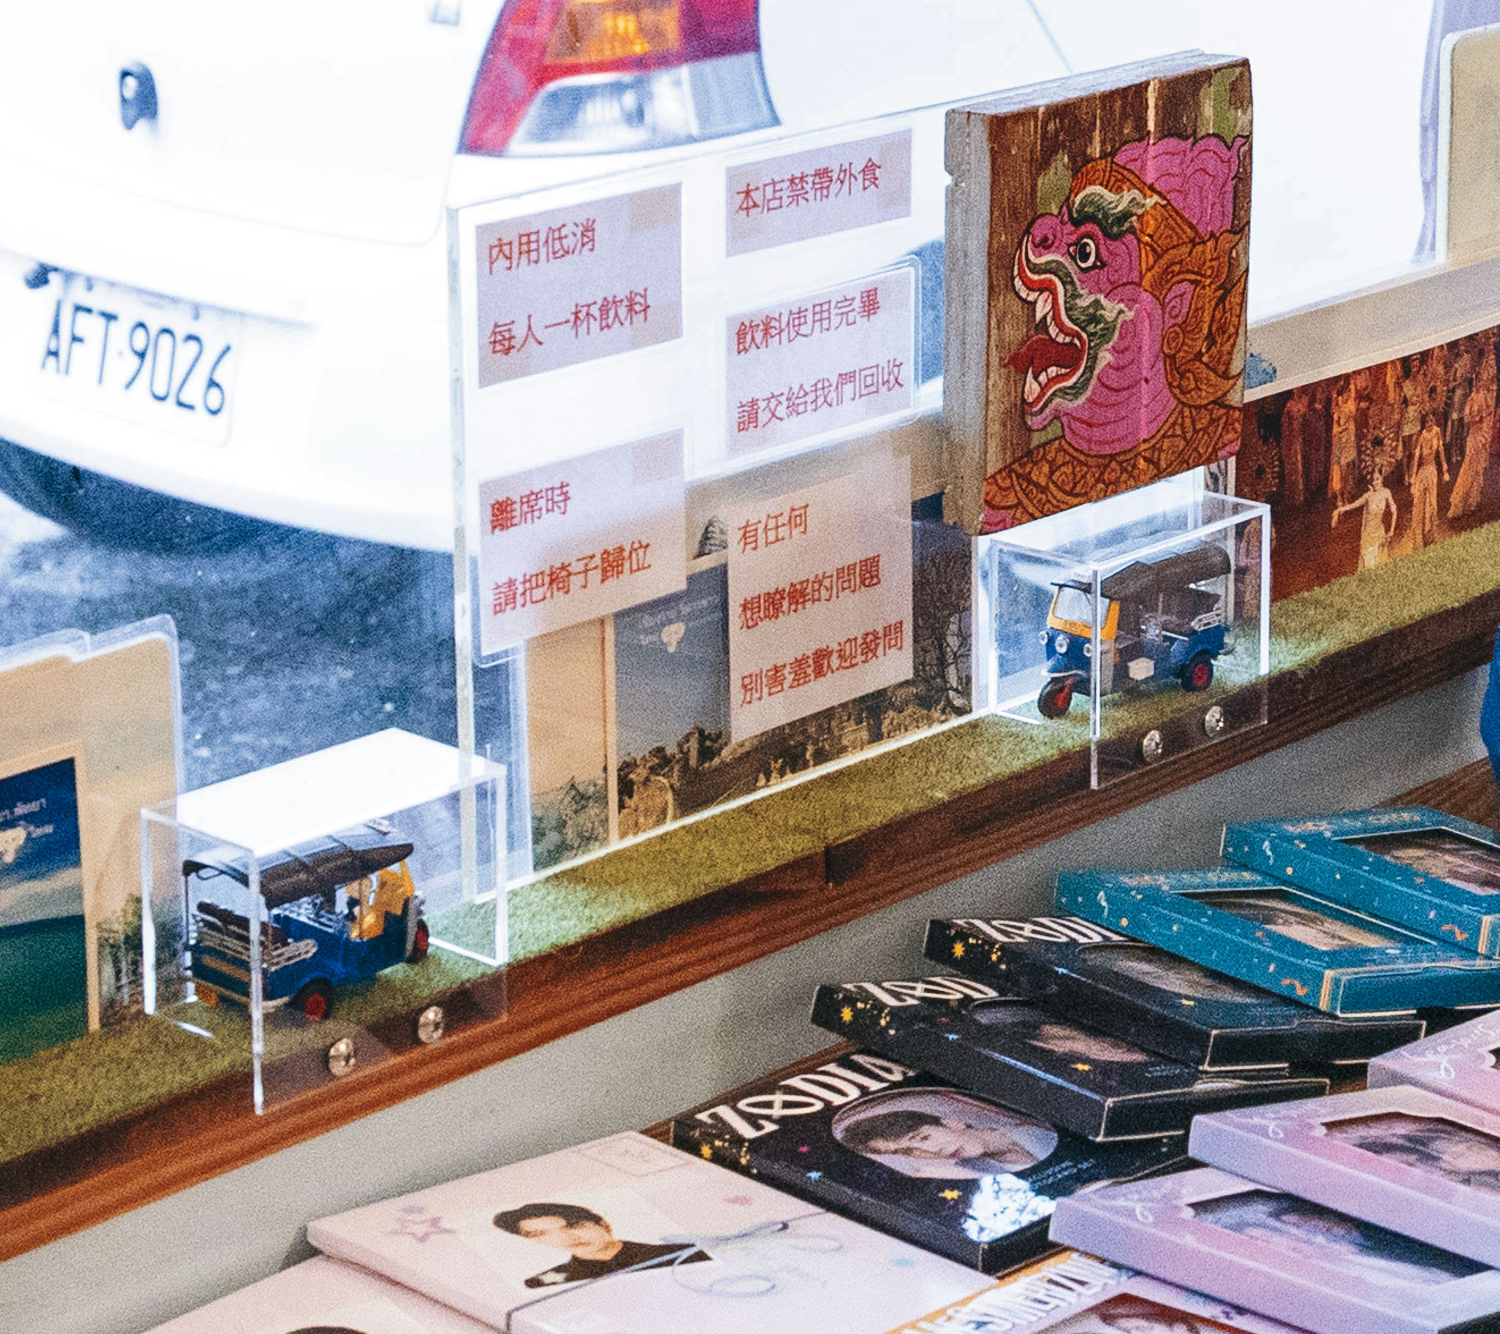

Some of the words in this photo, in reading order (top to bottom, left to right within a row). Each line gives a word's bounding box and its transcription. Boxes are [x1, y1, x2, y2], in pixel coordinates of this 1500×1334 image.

[735, 157, 881, 217] 本店禁帶外食
[488, 287, 652, 355] 每人一杯飲料
[735, 287, 880, 355] 飲料使用完畢
[736, 358, 904, 433] 請交給我們回收
[489, 481, 571, 535] 離席時
[737, 503, 810, 555] 有任何
[492, 540, 651, 616] 請把椅子歸位
[739, 554, 882, 630] 想瞭解的問題
[739, 620, 904, 707] 別害羞歡迎發問
[950, 917, 1130, 944] ZODI
[696, 1054, 916, 1140] ZODIA
